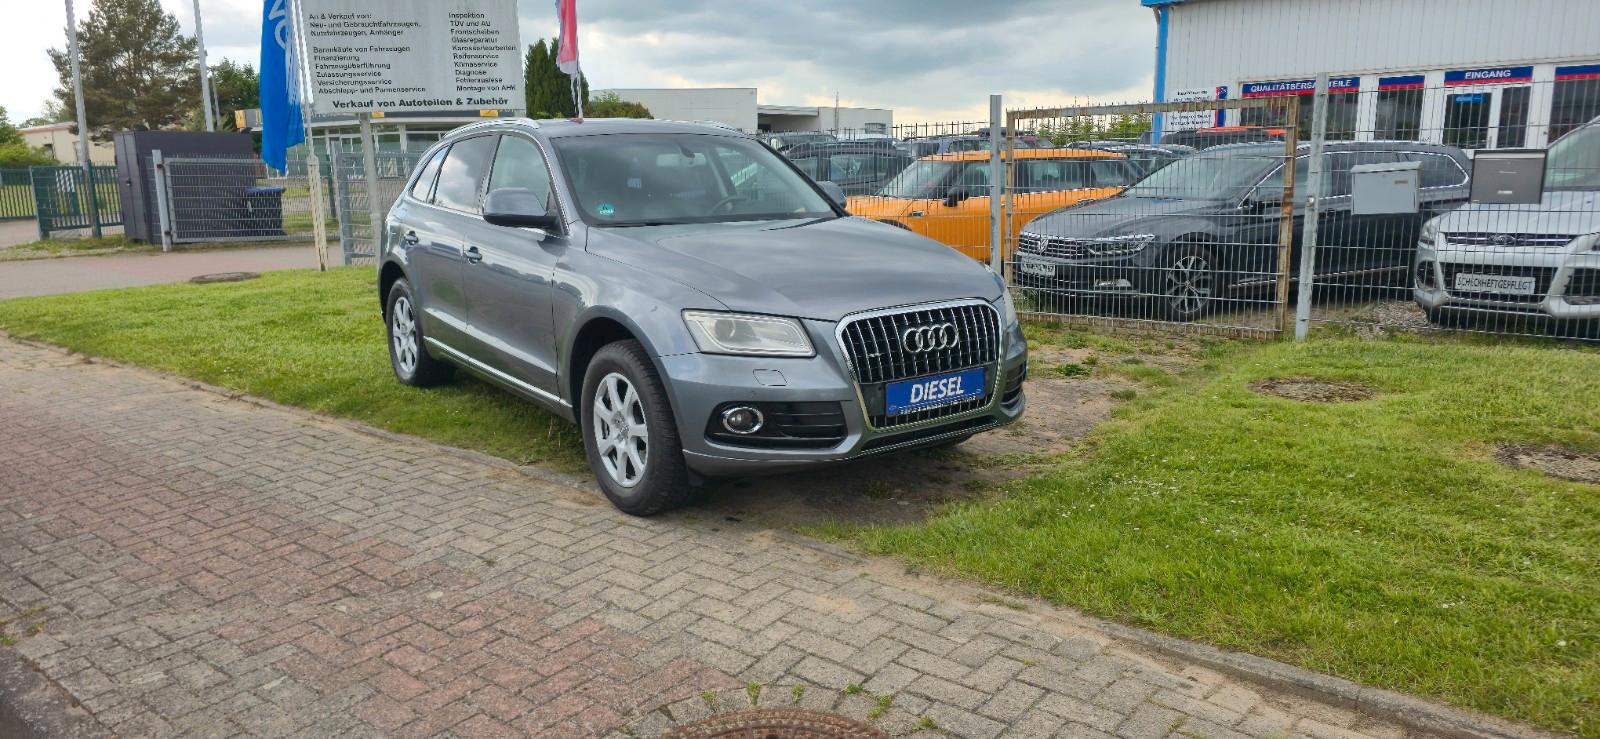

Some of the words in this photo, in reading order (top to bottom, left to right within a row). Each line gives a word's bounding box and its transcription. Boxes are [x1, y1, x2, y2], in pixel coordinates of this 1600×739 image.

[1464, 70, 1512, 79] EINGANG
[333, 100, 374, 108] Verkauf
[399, 98, 452, 107] Autoteilen
[1457, 276, 1532, 290] SCHECKHEFTGEPFLEGT
[910, 376, 965, 403] DIESEL
